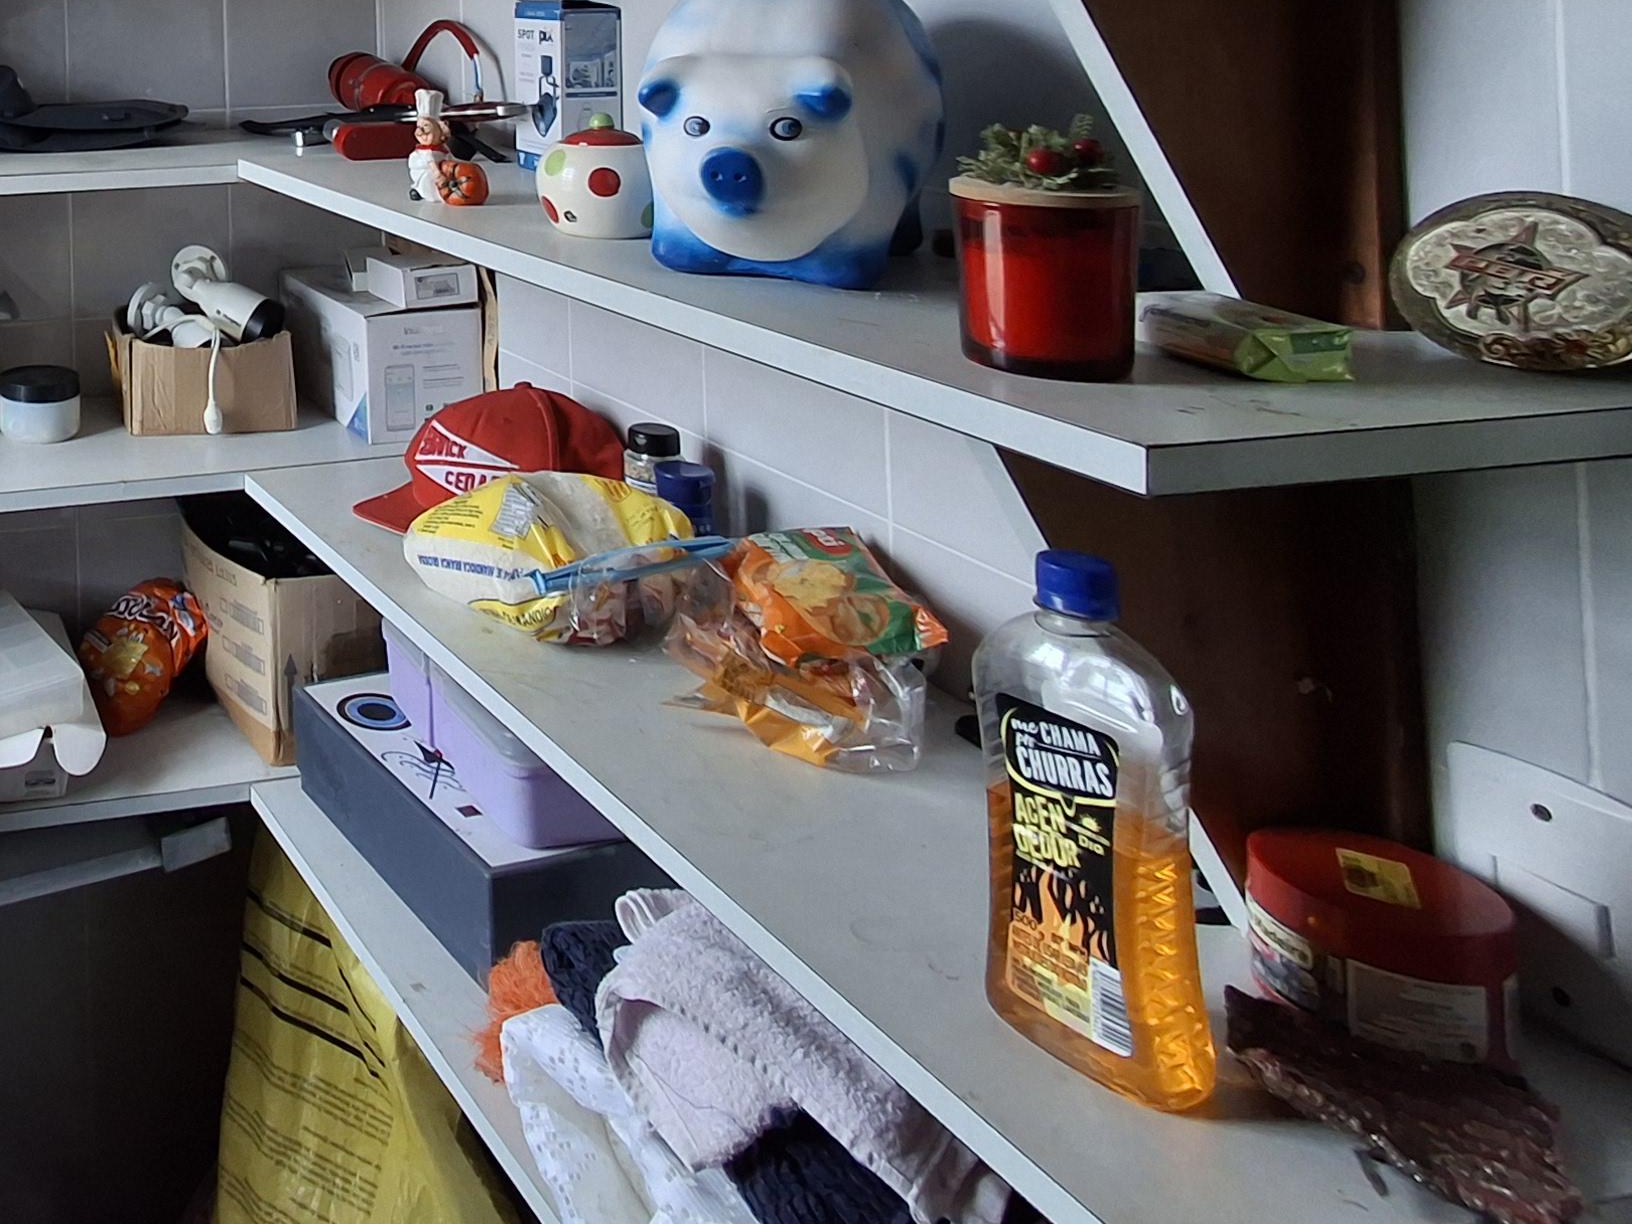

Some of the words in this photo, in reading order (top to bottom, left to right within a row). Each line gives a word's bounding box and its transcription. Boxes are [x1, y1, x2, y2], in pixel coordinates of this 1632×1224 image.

[517, 29, 535, 40] SPOT
[1039, 721, 1101, 756] CHAMA
[1016, 747, 1114, 798] CHURRAS
[1014, 792, 1067, 834] ACEN
